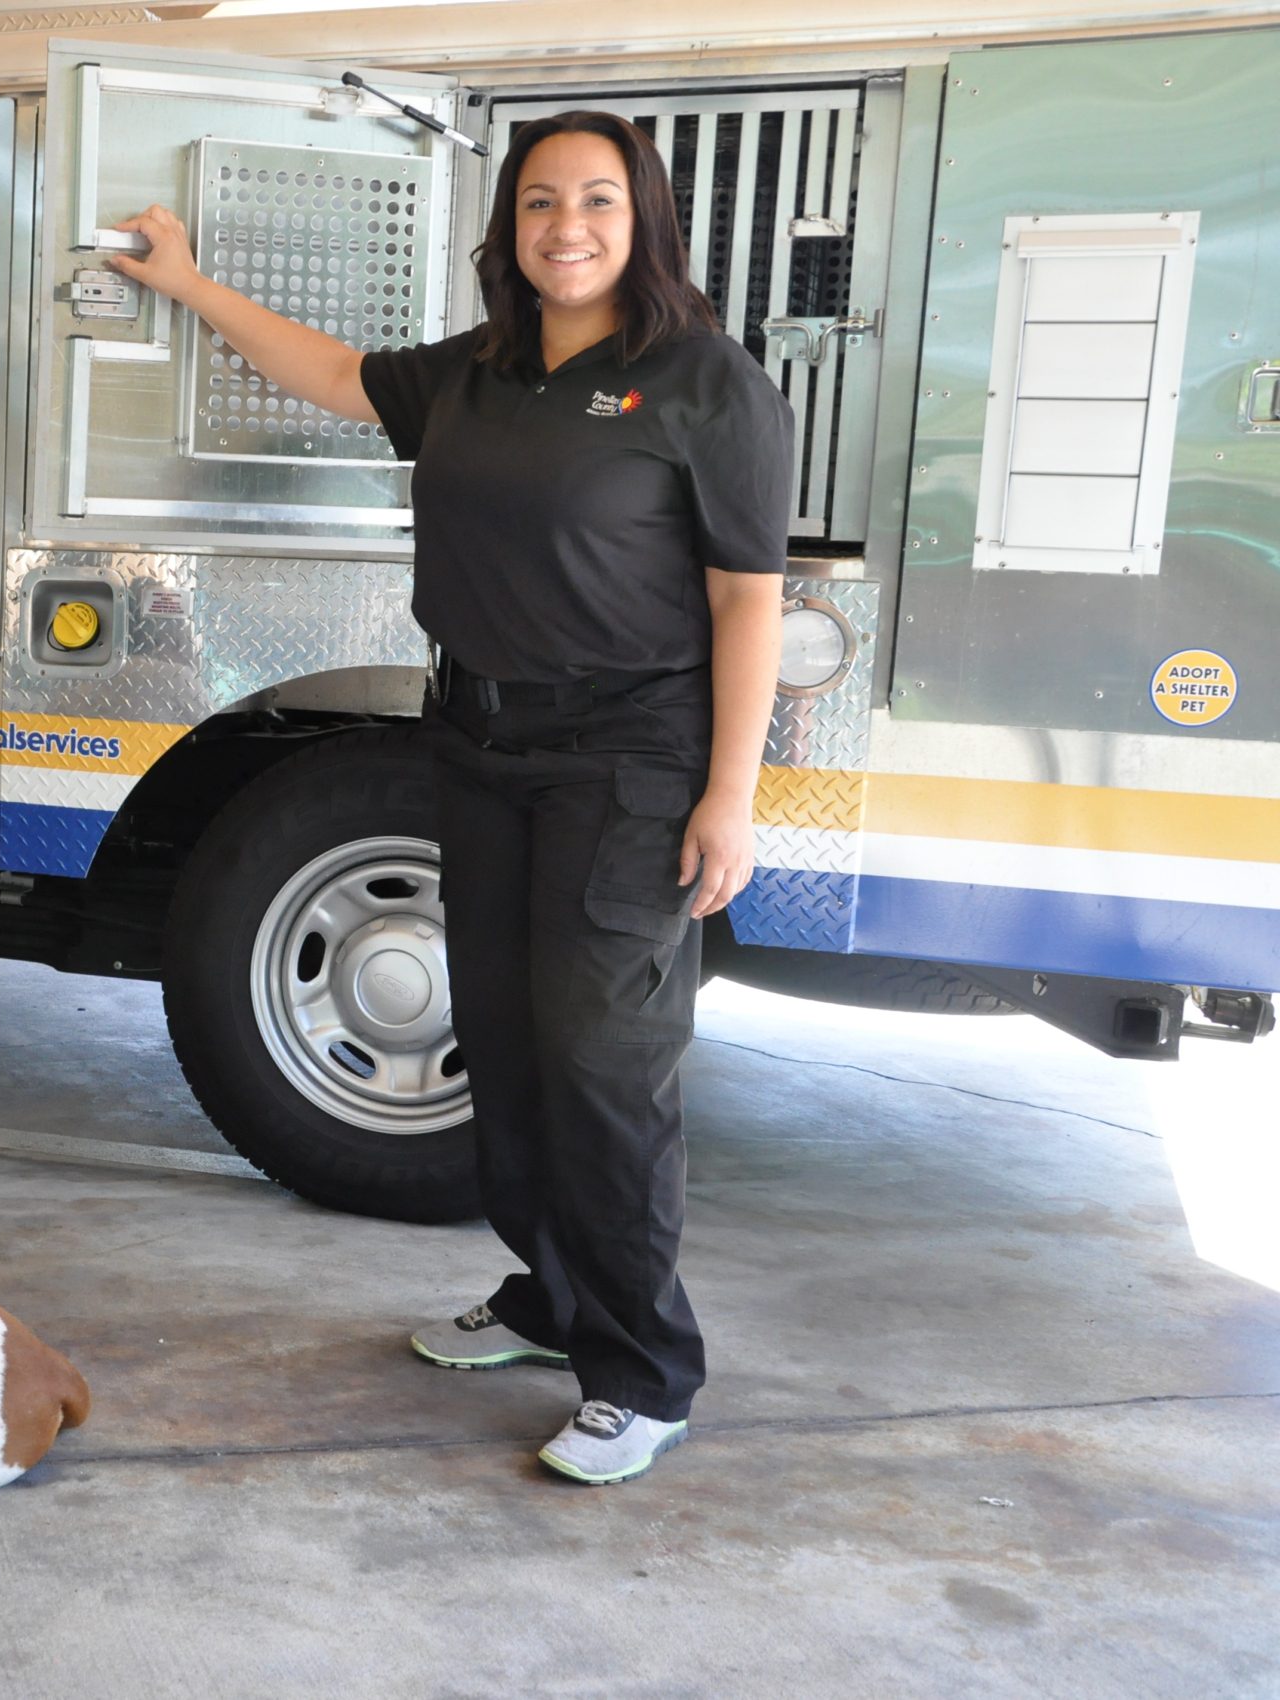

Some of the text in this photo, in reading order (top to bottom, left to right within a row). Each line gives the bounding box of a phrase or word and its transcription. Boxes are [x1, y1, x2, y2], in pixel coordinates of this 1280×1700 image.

[1169, 667, 1220, 679] ADOPT
[1155, 682, 1229, 697] A SHELTER
[1181, 701, 1205, 712] PET
